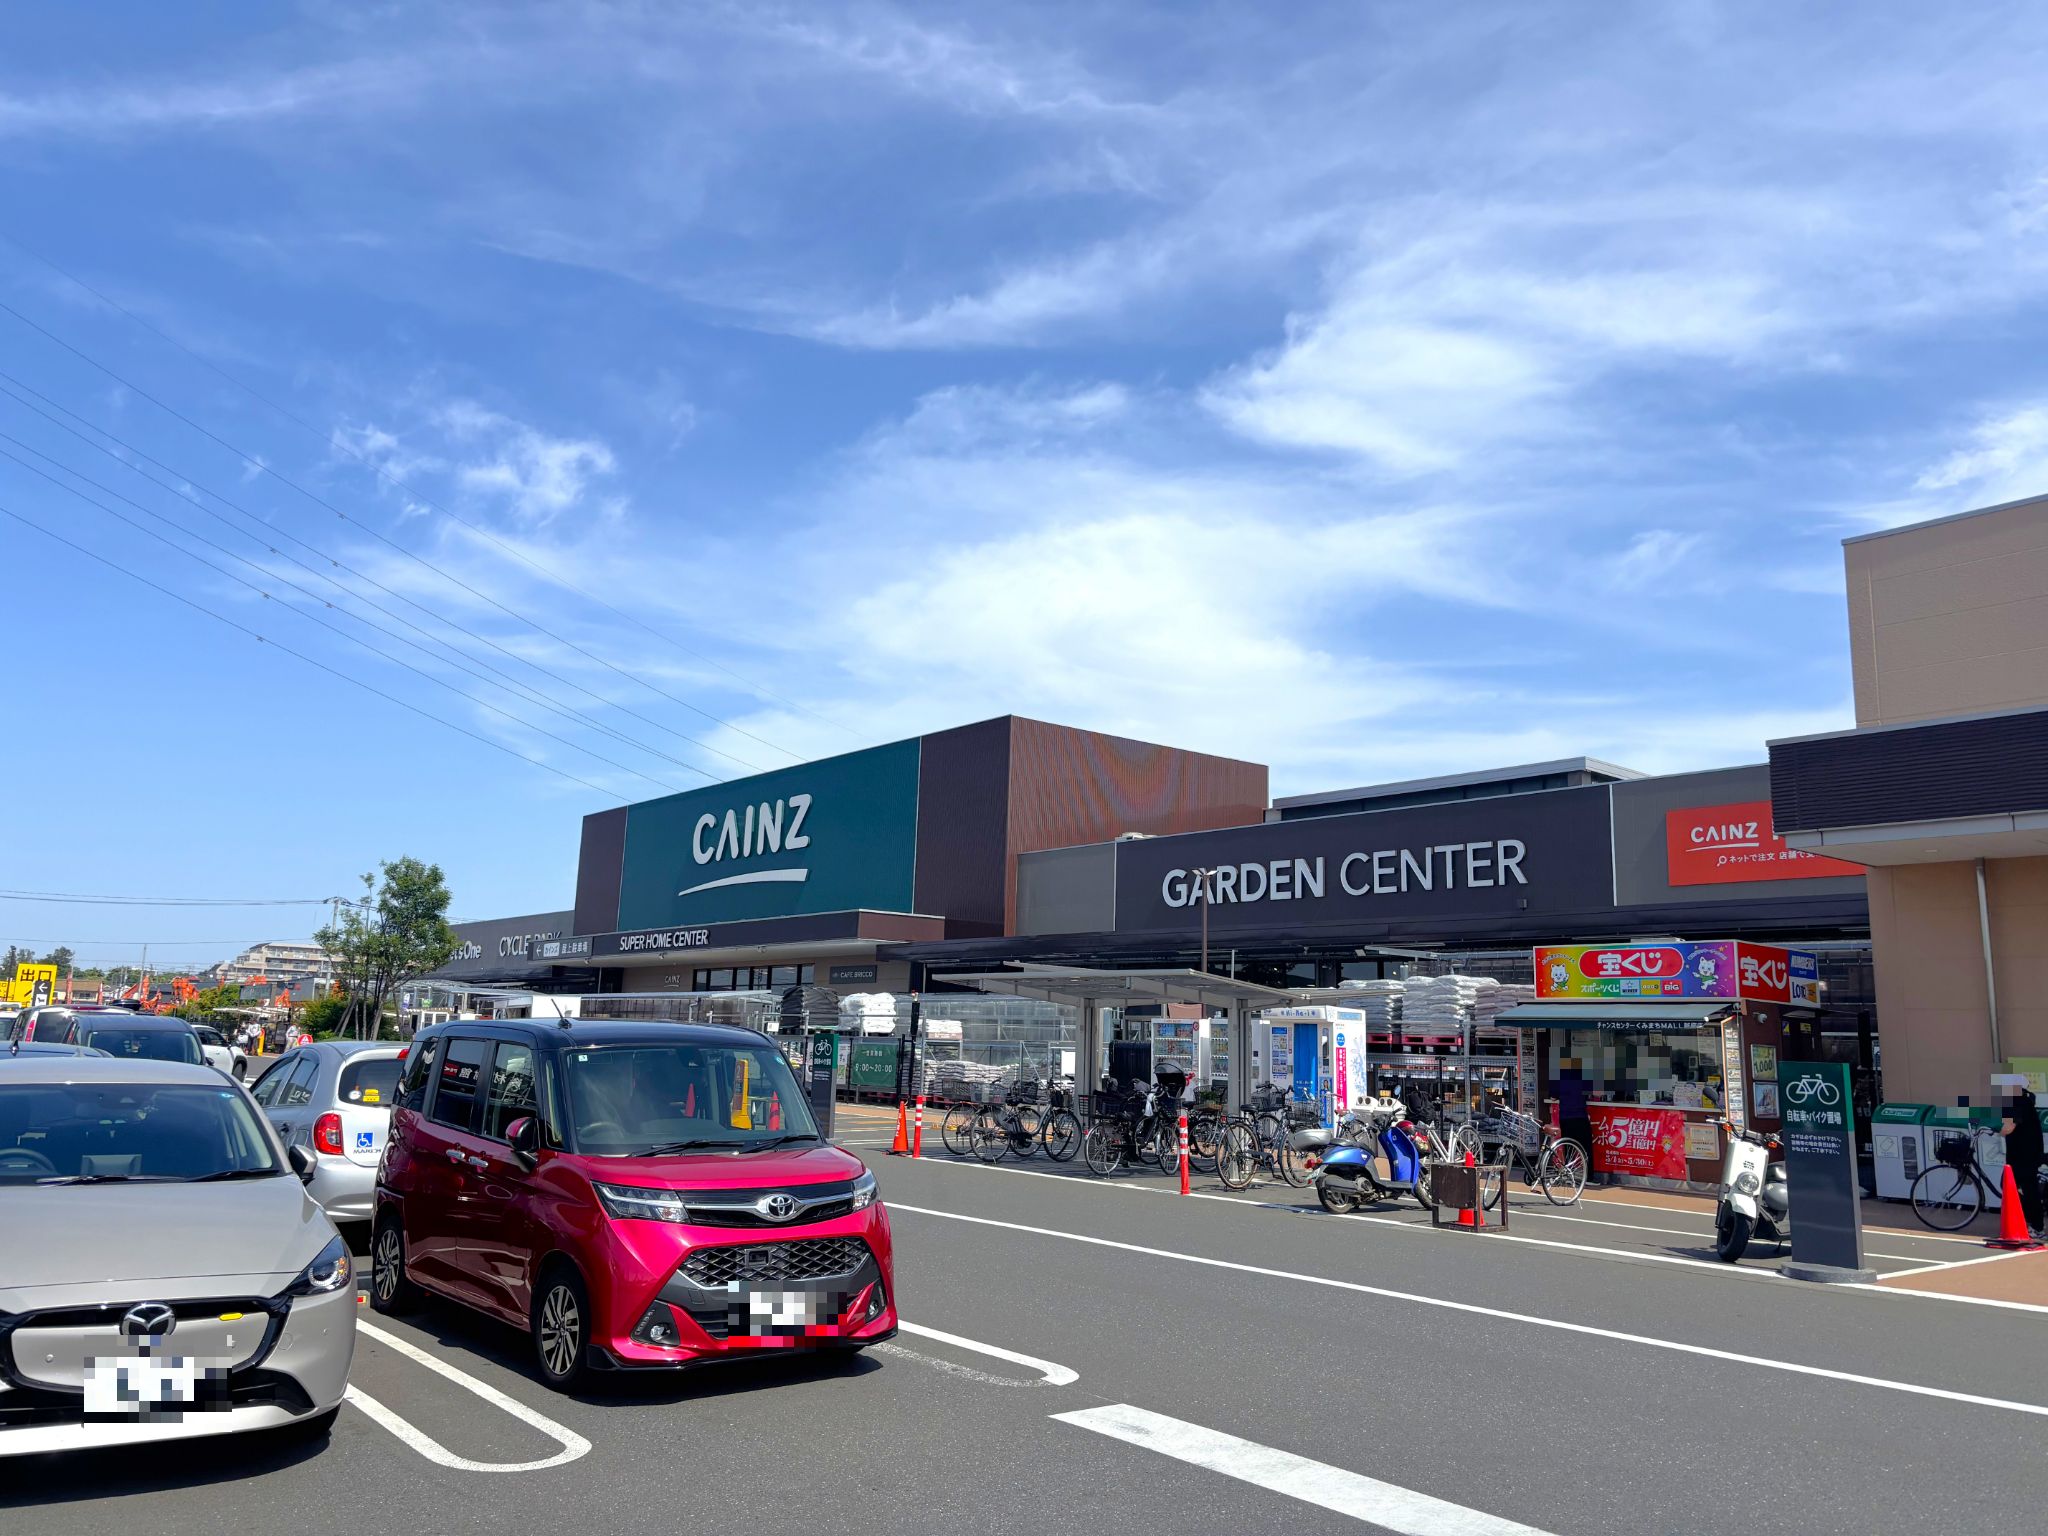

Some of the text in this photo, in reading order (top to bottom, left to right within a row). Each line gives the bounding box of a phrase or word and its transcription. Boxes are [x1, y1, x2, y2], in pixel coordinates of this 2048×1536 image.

[692, 793, 812, 865] CAINZ
[1690, 821, 1759, 843] CAINZ
[1729, 852, 1775, 863] ネットで注文
[1162, 839, 1528, 908] GARDEN CENTER
[499, 934, 532, 957] CYCLE
[619, 929, 708, 951] SUPER HOME CENTER
[20, 967, 52, 981] 出口
[1597, 951, 1663, 975] 宝くじ
[1739, 955, 1787, 990] 宝くじ
[1580, 982, 1620, 993] スポーツくじ
[1786, 1109, 1842, 1125] 自転車・バイク置場
[1608, 1116, 1660, 1148] 5億円
